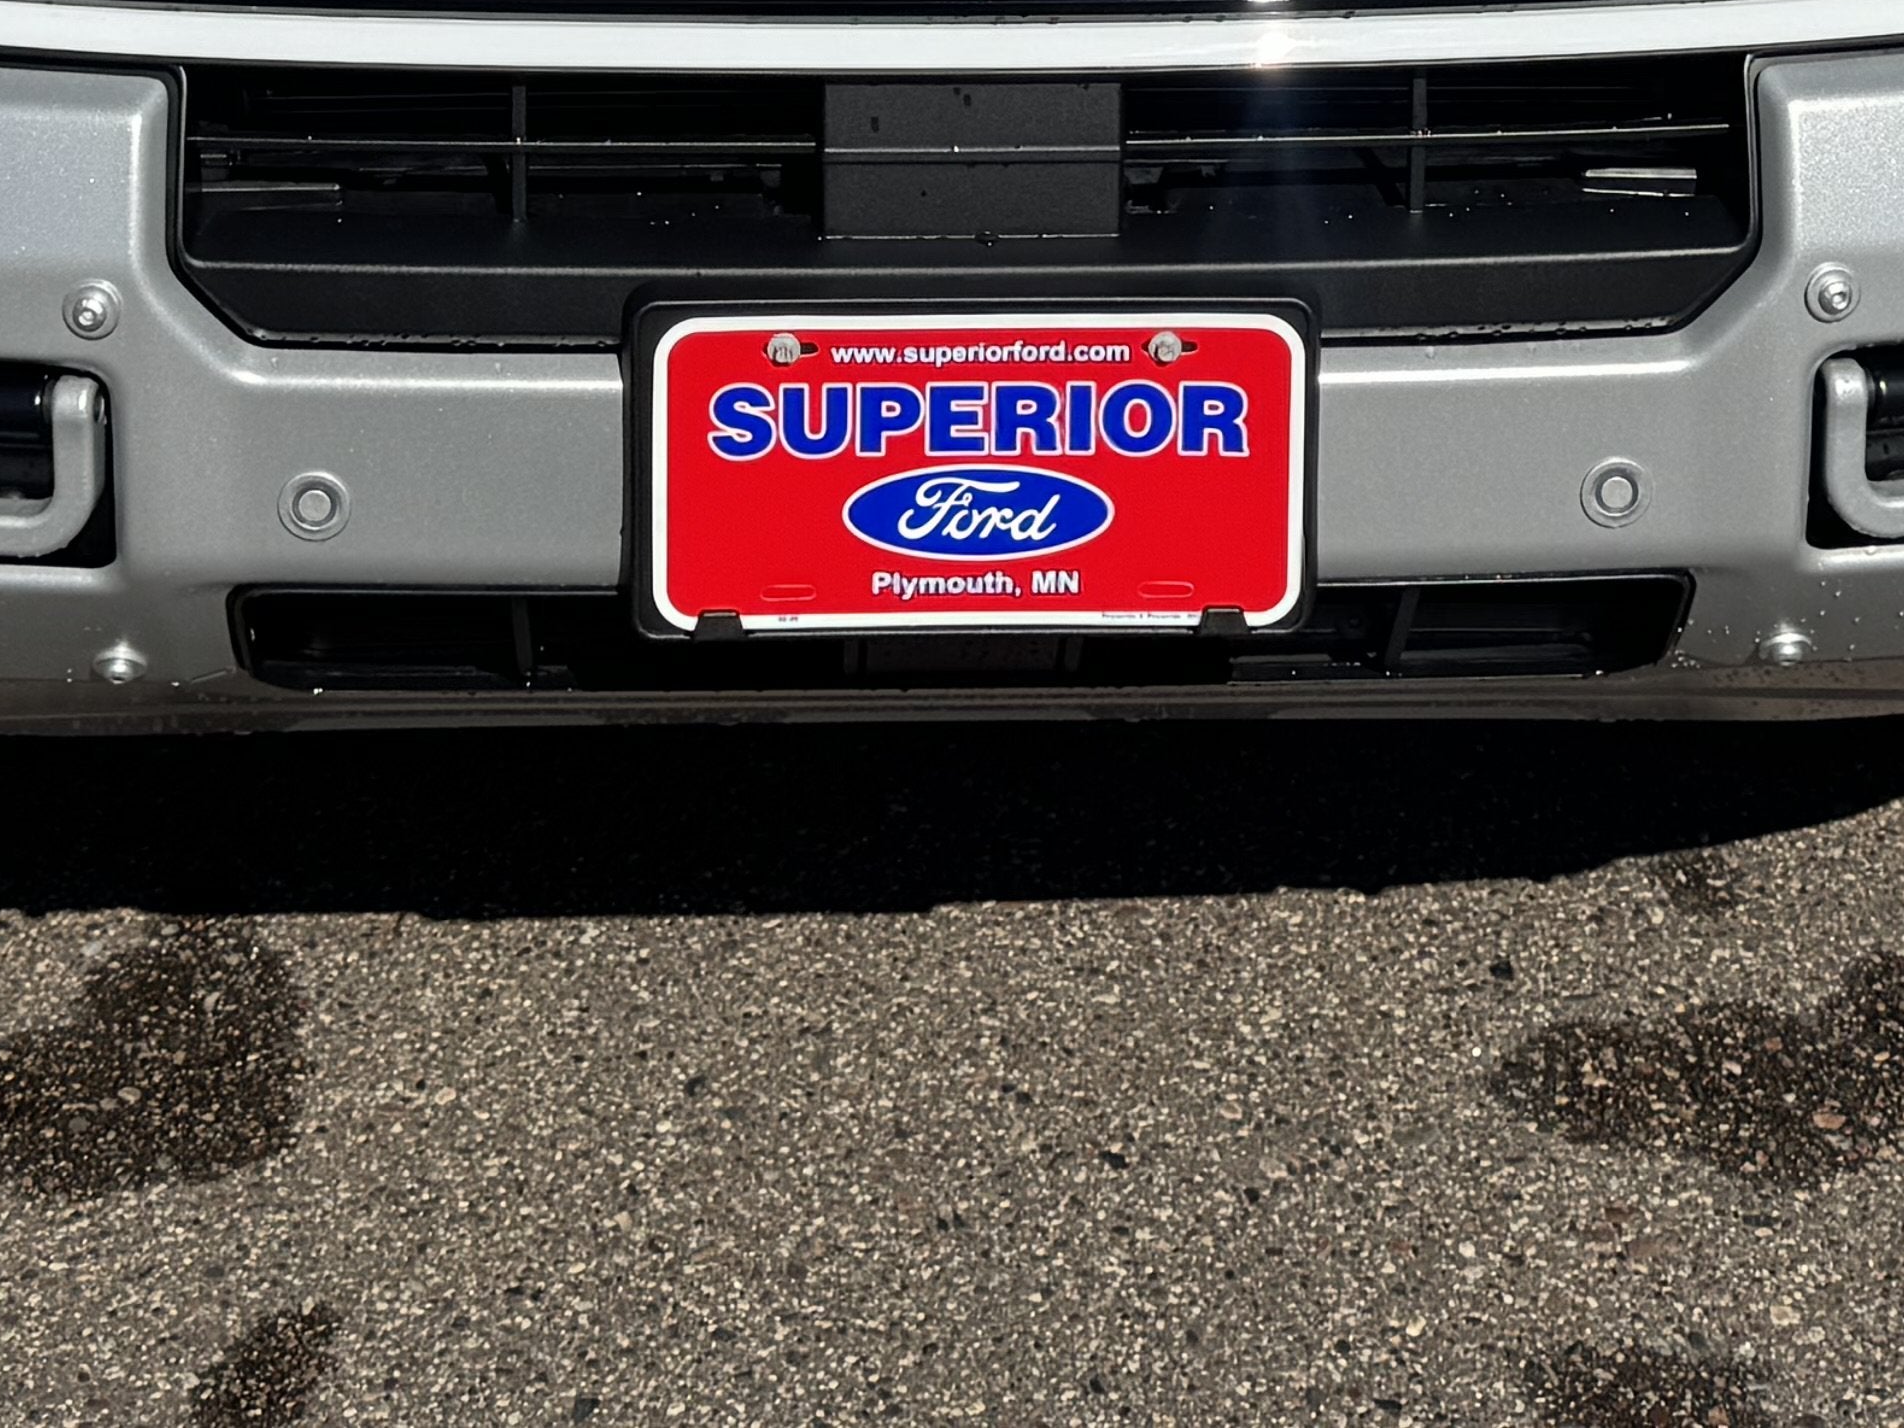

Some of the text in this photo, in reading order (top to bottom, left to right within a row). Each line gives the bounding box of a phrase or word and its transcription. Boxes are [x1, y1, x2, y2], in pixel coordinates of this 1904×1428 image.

[830, 340, 1131, 367] www.superiorford.com
[708, 378, 1250, 461] SUPERIOR
[897, 477, 1061, 541] Ford
[871, 570, 1080, 601] Plymouth, MN
